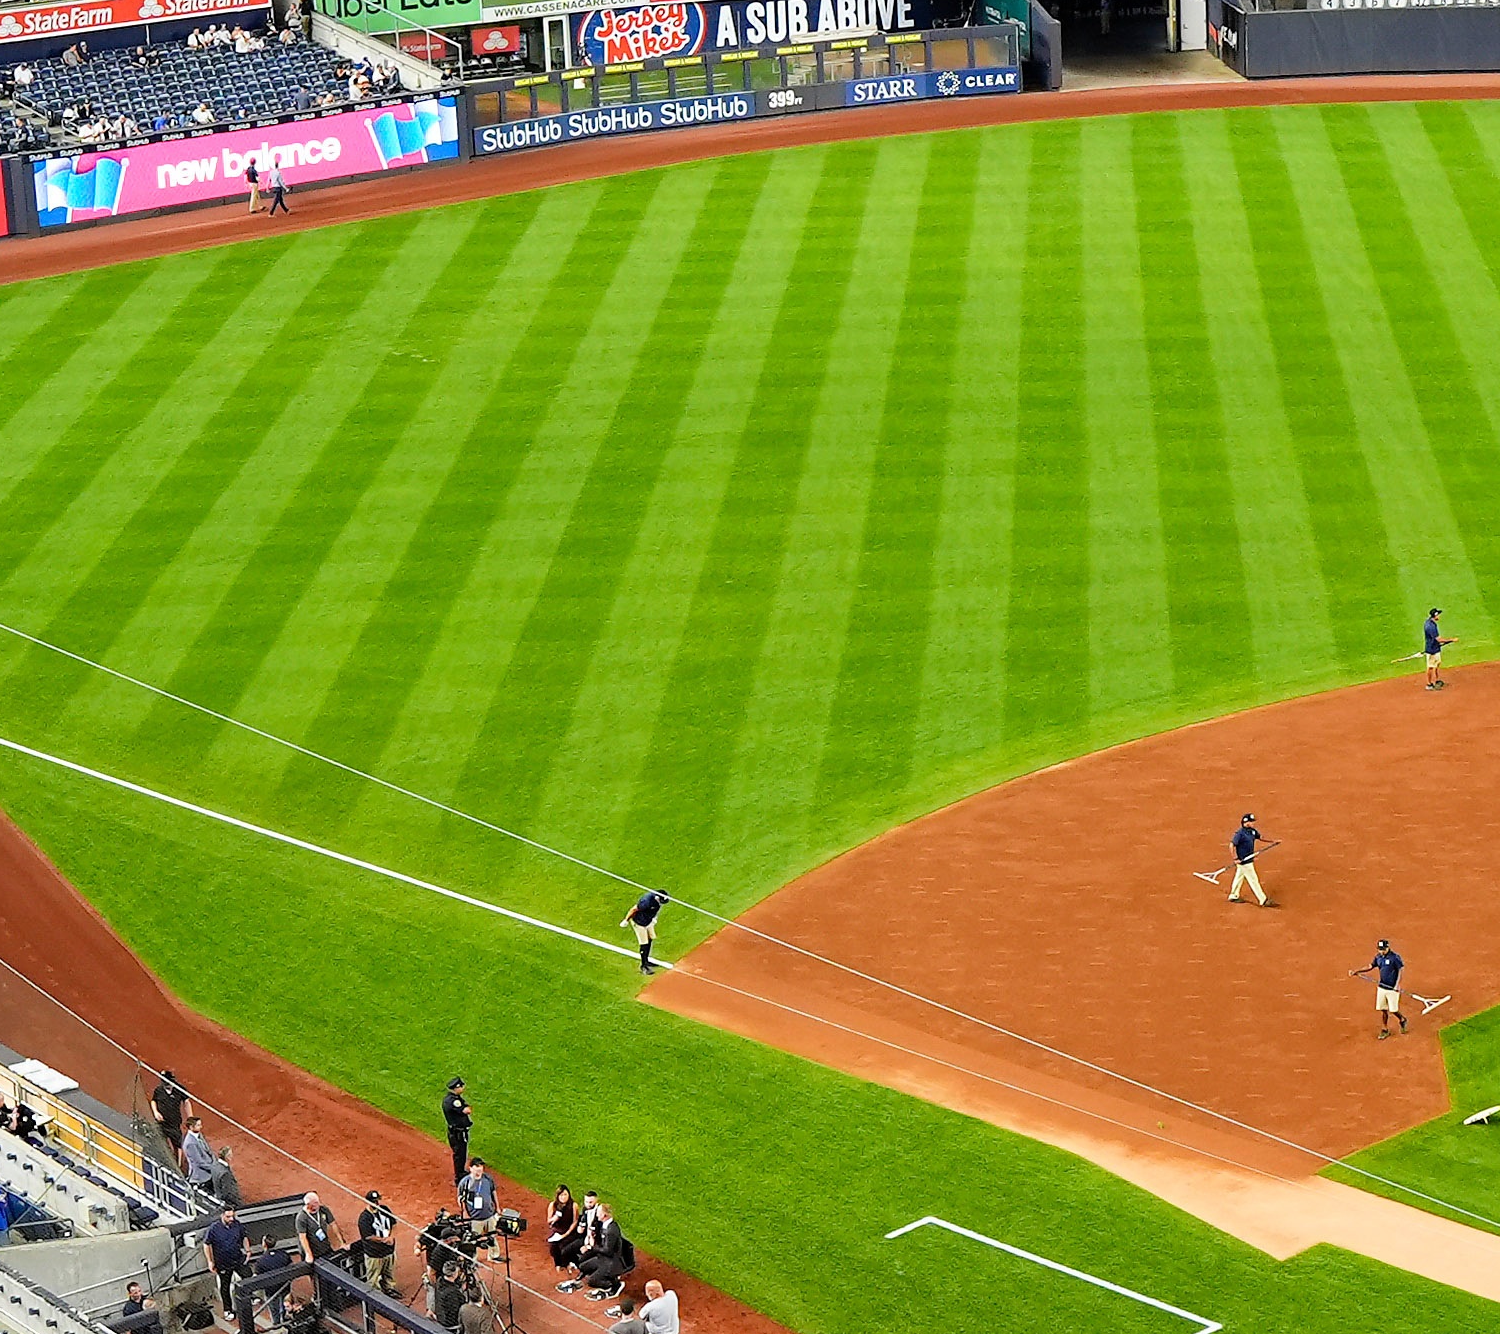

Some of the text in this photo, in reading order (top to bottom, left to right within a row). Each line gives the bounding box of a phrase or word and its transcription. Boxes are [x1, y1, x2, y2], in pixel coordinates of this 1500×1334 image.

[597, 4, 685, 37] Jersey
[716, 15, 738, 48] A
[854, 78, 917, 102] STARR
[965, 73, 1014, 88] CLEAR
[768, 91, 794, 109] 399
[482, 95, 748, 152] StubHub StubHub StubHub
[157, 158, 231, 189] new
